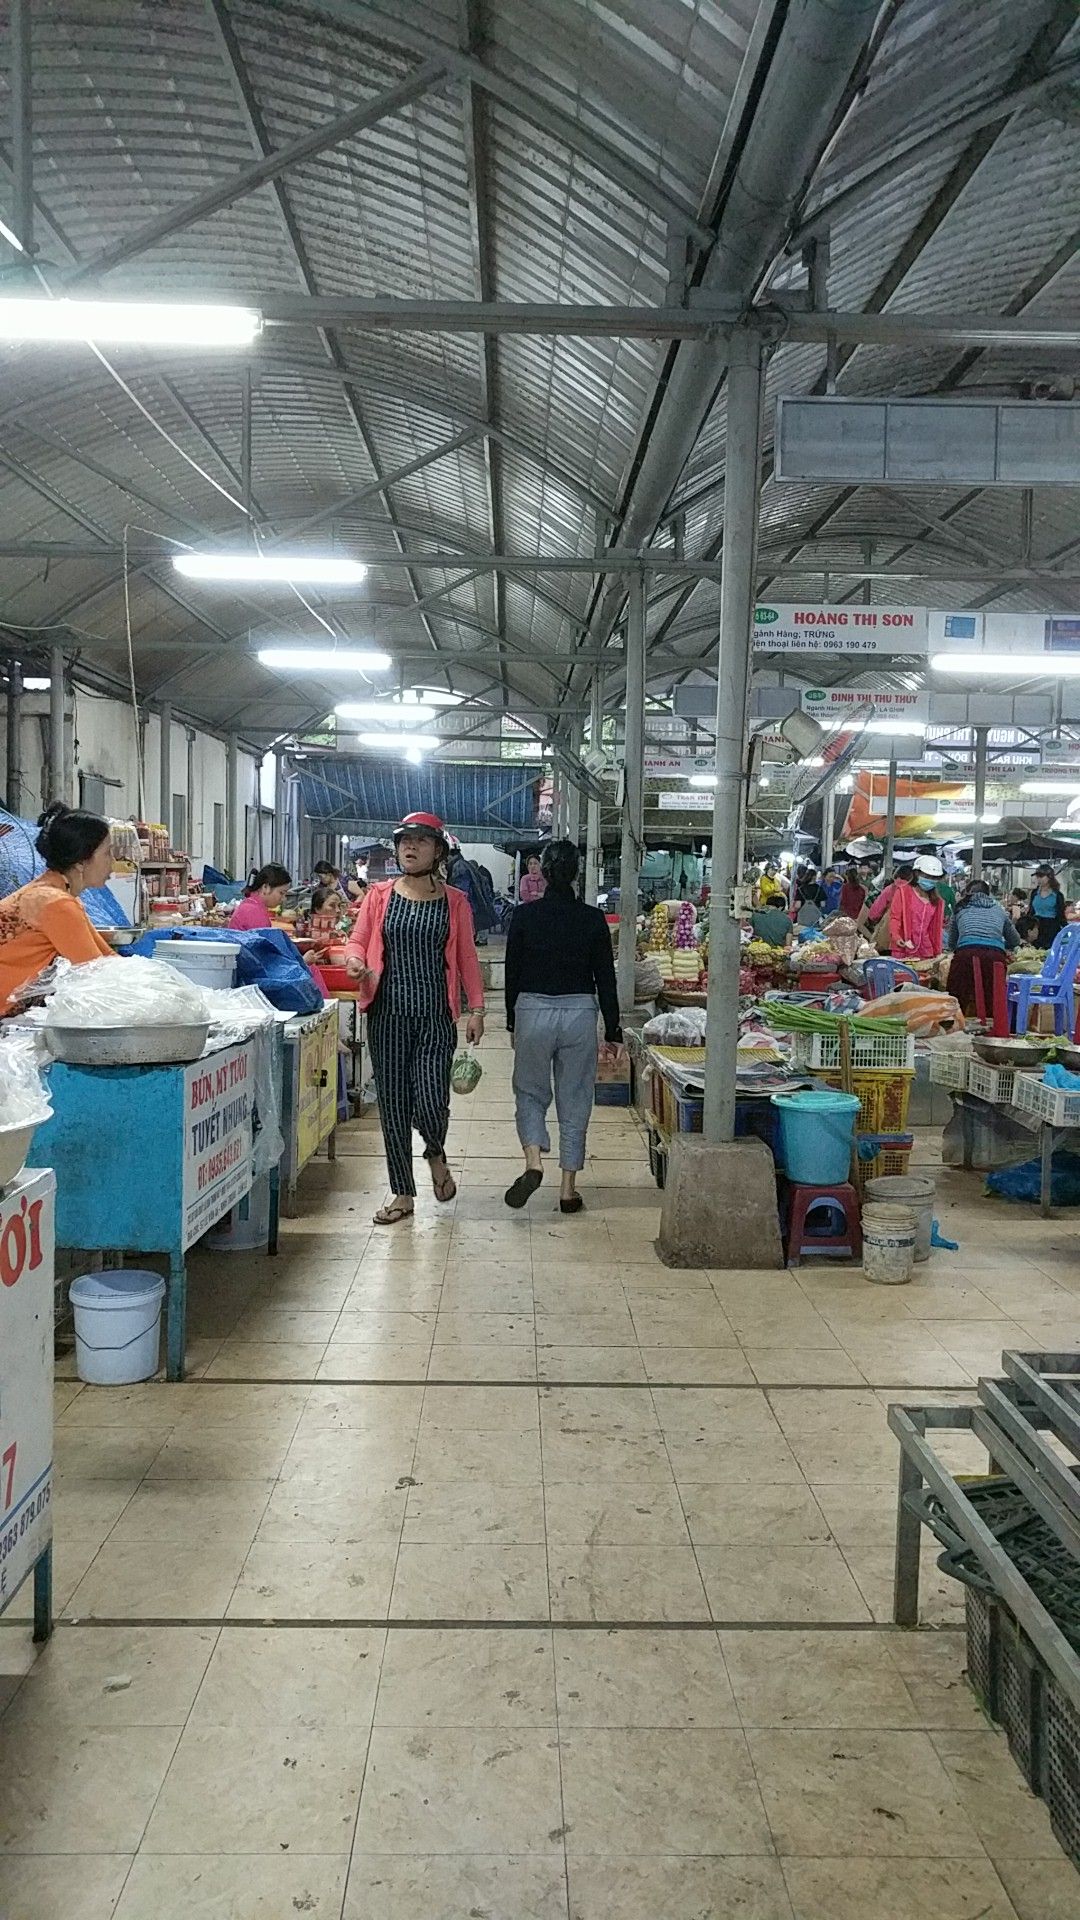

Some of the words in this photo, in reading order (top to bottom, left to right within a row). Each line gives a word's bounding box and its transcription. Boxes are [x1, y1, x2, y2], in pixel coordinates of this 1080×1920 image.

[853, 613, 877, 628] THỊ
[882, 613, 914, 627] SƠN
[754, 630, 774, 640] gành
[754, 640, 766, 650] iện
[791, 640, 806, 648] liên
[824, 641, 843, 649] 0963
[846, 642, 860, 650] 190
[862, 642, 877, 650] 479
[874, 694, 892, 704] THU
[191, 1070, 215, 1110] BÚN,
[192, 1102, 220, 1156] TUYẾT
[222, 1092, 248, 1136] NHUNG
